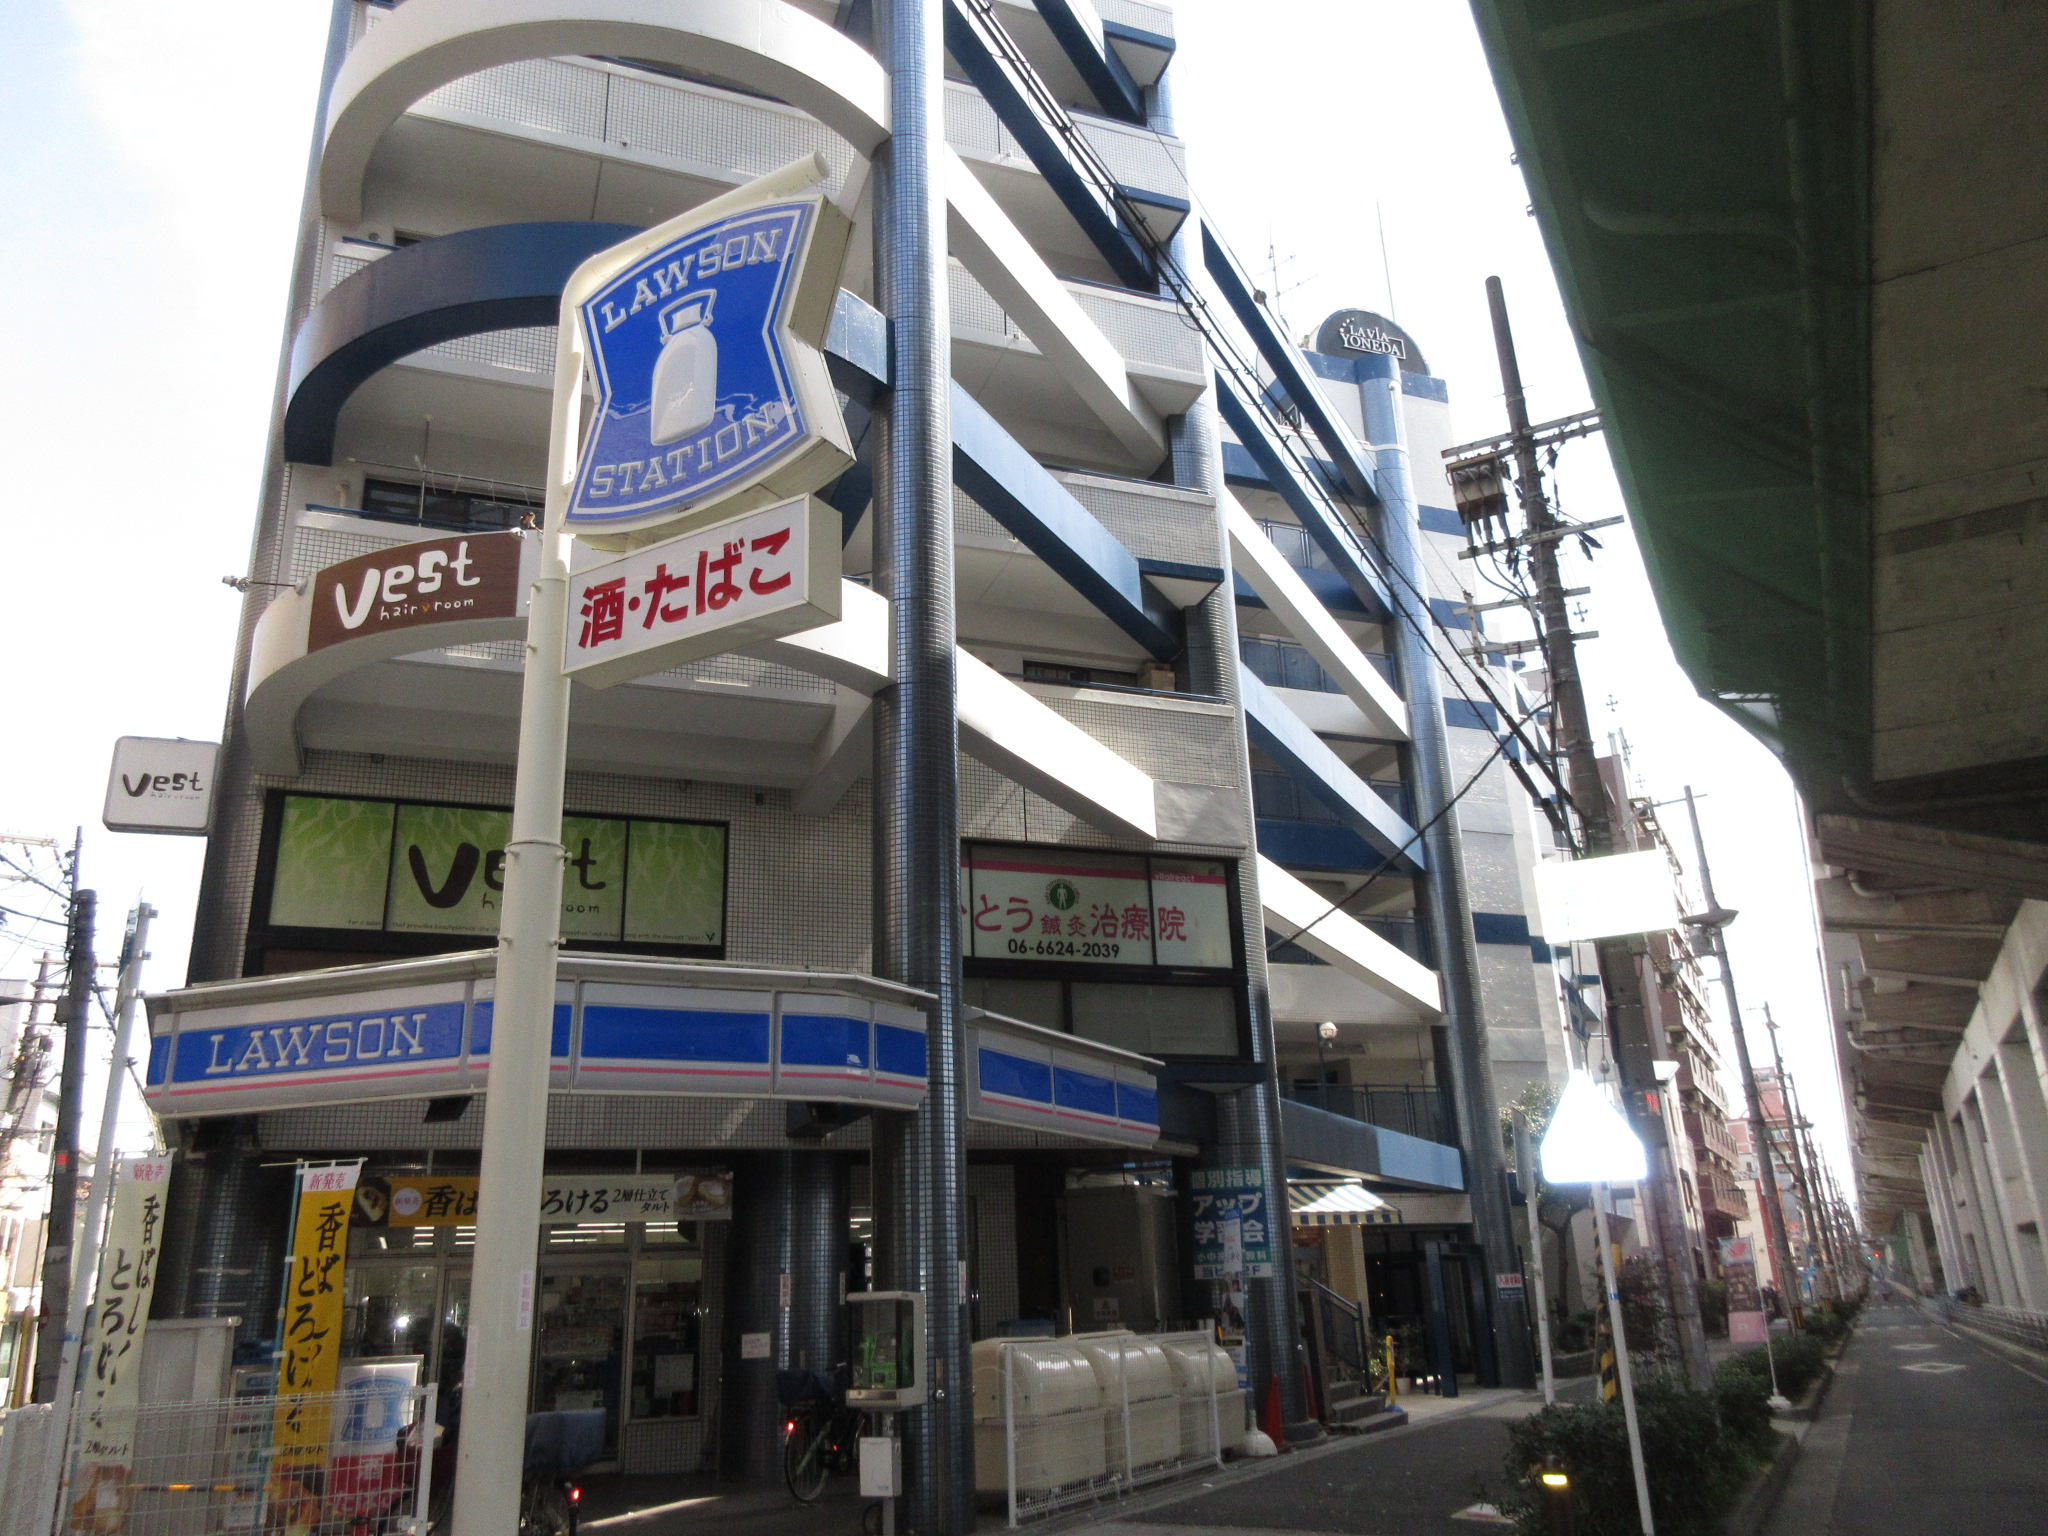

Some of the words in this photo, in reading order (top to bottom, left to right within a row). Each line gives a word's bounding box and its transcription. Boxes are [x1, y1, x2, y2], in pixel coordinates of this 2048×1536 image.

[600, 228, 783, 333] LAWSON
[1340, 332, 1401, 356] YONEDA
[589, 401, 775, 498] STATION
[578, 526, 792, 650] 酒・たばこ
[380, 603, 418, 621] hair
[434, 598, 474, 610] room
[963, 893, 1188, 943] とう鍼灸治療院
[1007, 938, 1120, 959] 06-6624-2039
[206, 1012, 427, 1074] LAWSON
[309, 1171, 347, 1190] 新発売
[612, 1188, 670, 1204] 2層仕立て
[640, 1201, 670, 1215] タルト
